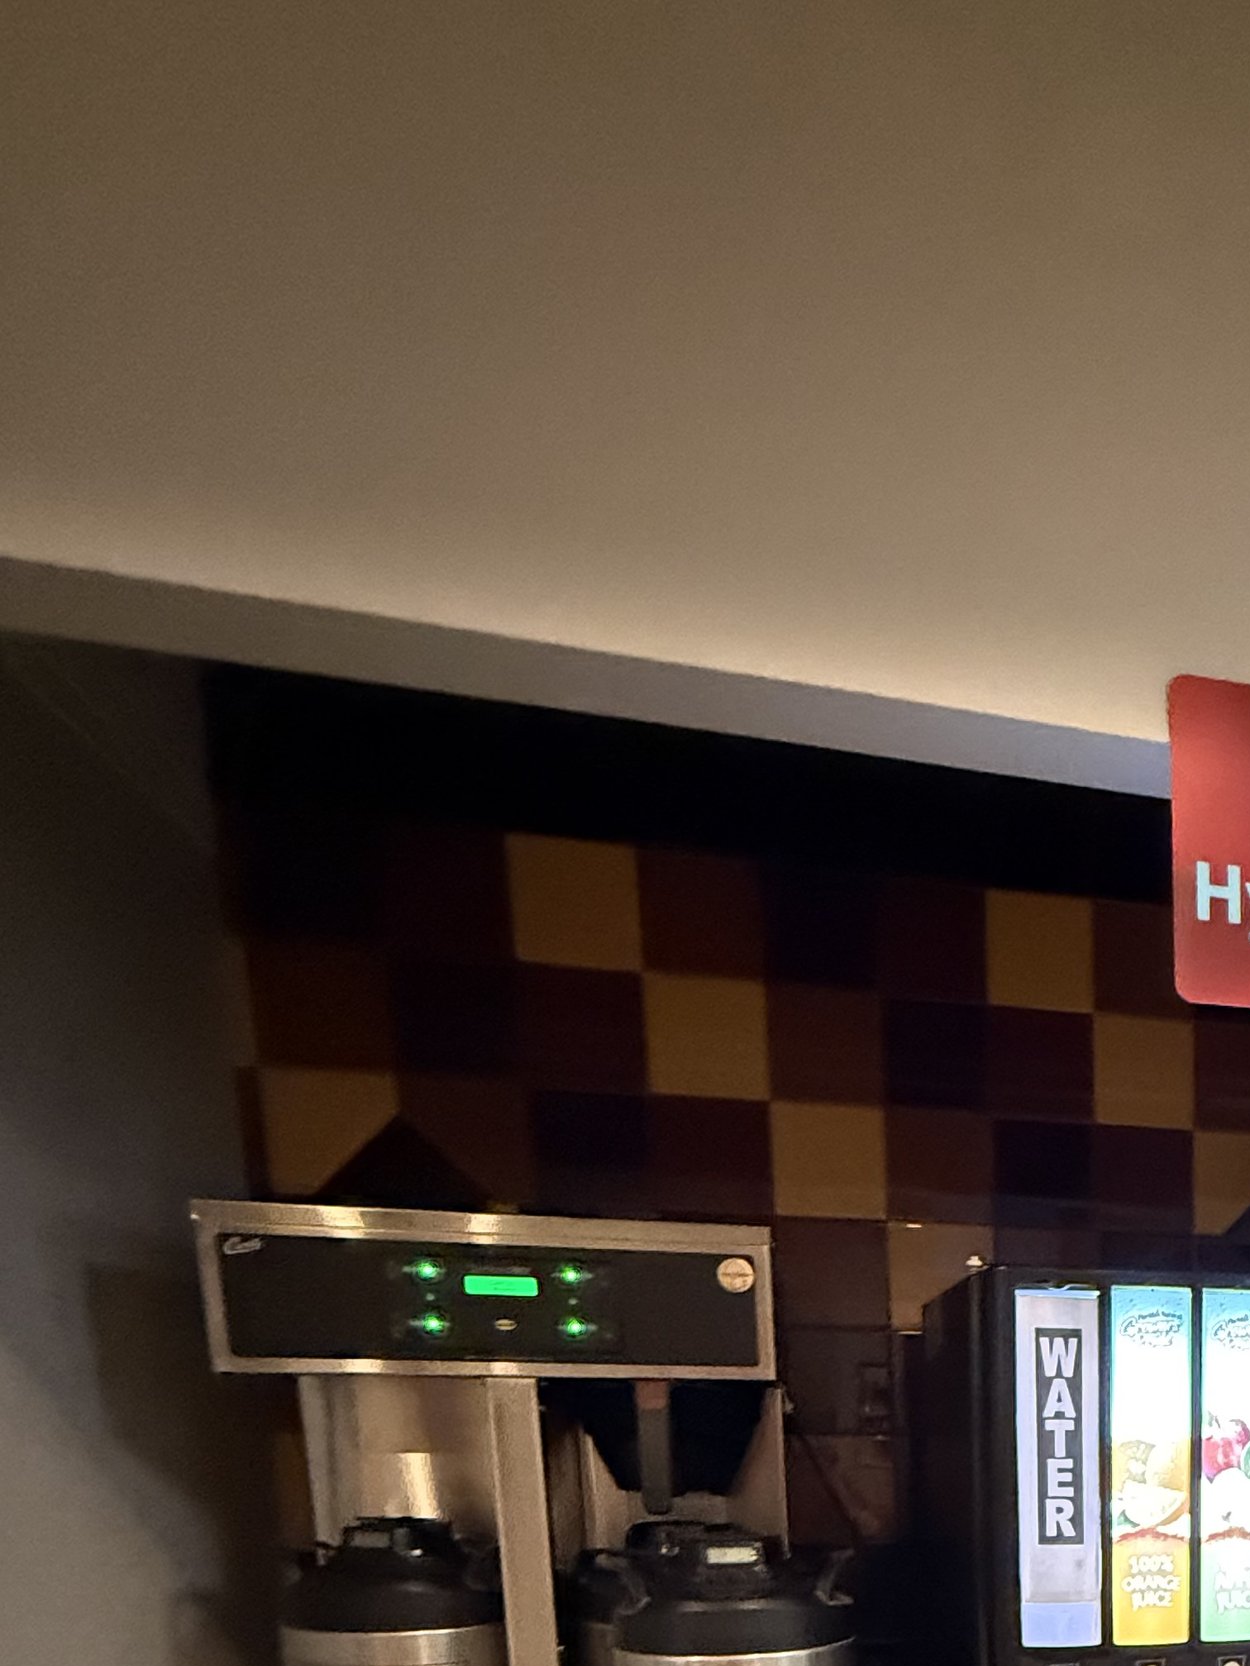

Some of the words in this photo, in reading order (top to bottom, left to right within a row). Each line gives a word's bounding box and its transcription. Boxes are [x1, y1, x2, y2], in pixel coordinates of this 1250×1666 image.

[1038, 1336, 1079, 1537] WATER
[1128, 1553, 1174, 1574] 100%
[1121, 1573, 1182, 1593] ORANGE
[1130, 1589, 1173, 1613] JUICE
